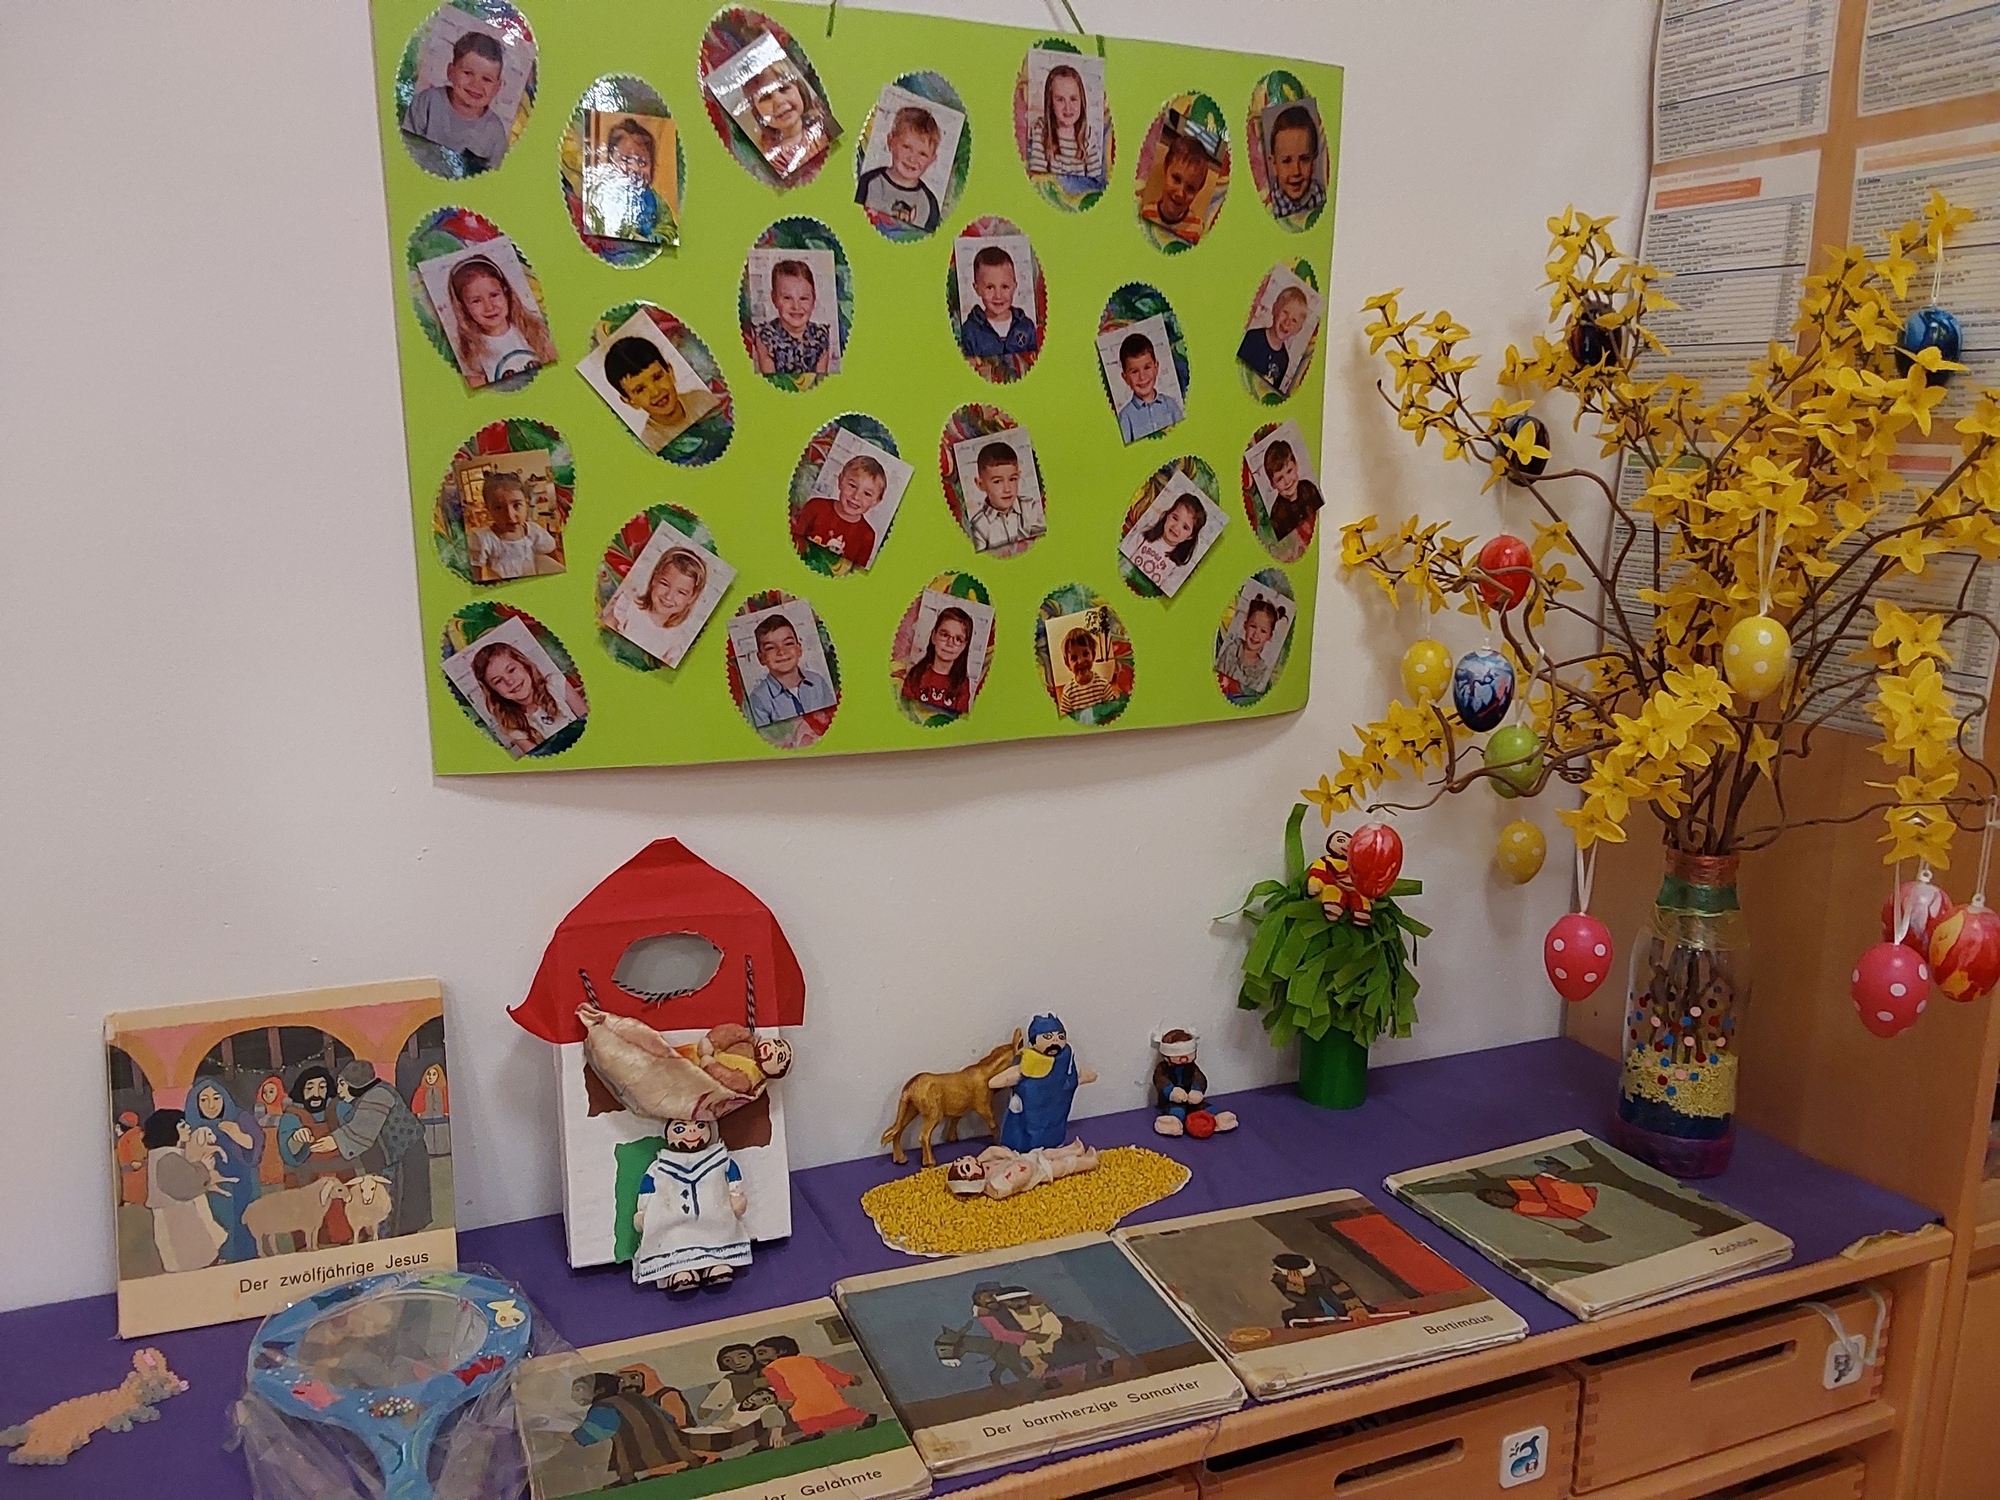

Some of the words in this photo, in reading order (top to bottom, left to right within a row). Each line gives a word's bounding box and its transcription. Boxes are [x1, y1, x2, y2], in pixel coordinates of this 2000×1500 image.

[239, 1278, 268, 1294] Der
[279, 1260, 375, 1288] zwölfjährige
[385, 1251, 430, 1270] Jesus
[982, 1422, 1012, 1438] Der
[1022, 1399, 1118, 1429] barmherzige
[1126, 1379, 1201, 1404] Samariter
[800, 1469, 883, 1496] Gelähmte
